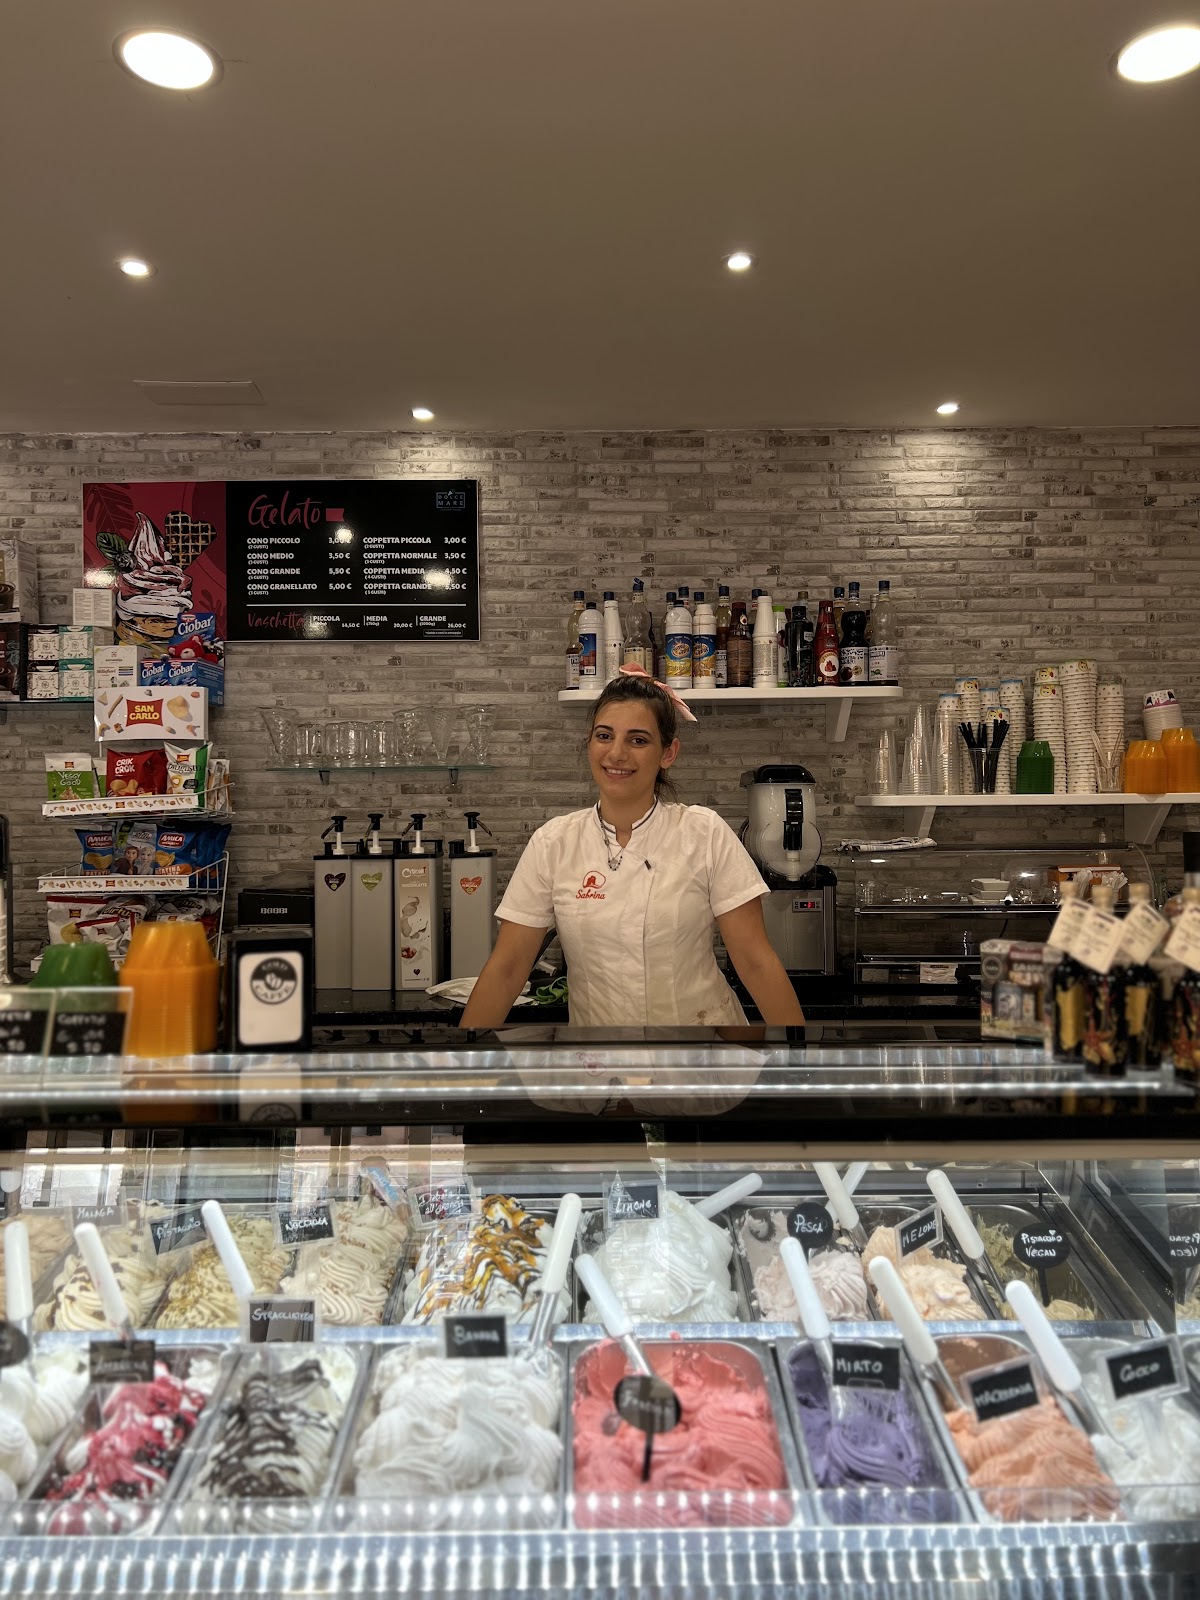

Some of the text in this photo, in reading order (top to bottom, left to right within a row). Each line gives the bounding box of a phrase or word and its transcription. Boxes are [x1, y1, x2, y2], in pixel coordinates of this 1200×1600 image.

[247, 490, 323, 530] Gelato
[444, 537, 460, 545] 3,00
[444, 552, 460, 560] 3,50
[328, 583, 346, 591] 5,00
[177, 615, 214, 636] Ciobar
[141, 663, 166, 679] Ciobar
[168, 662, 195, 678] Ciobar
[134, 705, 154, 713] SAN
[129, 712, 160, 720] CARLO
[116, 758, 134, 766] CRIK
[114, 765, 136, 774] CROK
[87, 835, 112, 843] AMICA
[575, 889, 606, 900] Sabrina
[902, 1218, 938, 1248] MELONE
[1025, 1245, 1057, 1258] VEGAN
[836, 1358, 883, 1375] MIRTO
